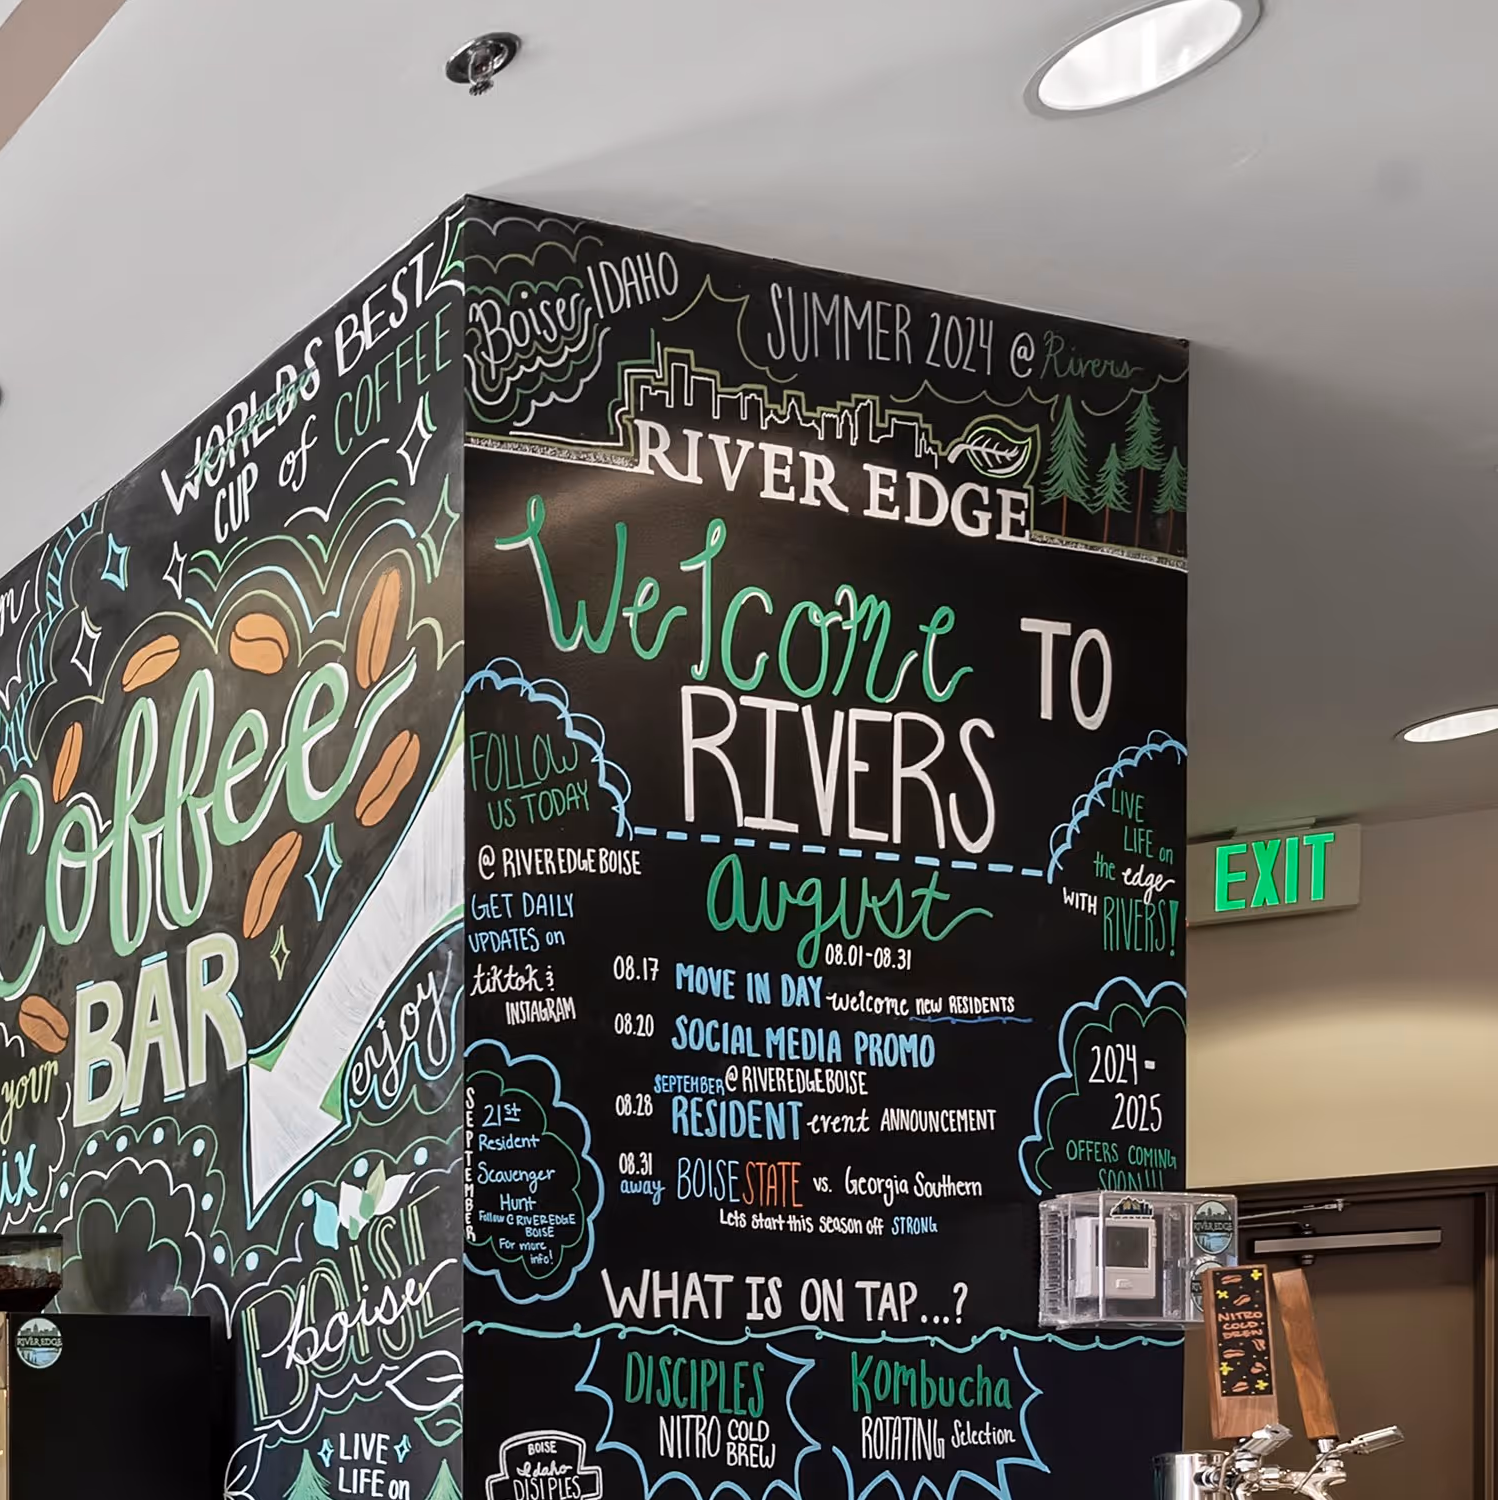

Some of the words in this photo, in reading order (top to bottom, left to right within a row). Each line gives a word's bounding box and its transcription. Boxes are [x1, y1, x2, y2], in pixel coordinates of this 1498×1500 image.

[590, 250, 681, 321] IDAHO
[334, 241, 435, 377] BEST
[767, 281, 913, 363] SUMMER
[924, 313, 995, 376] 2024
[1008, 331, 1036, 379] @
[1041, 330, 1144, 381] Rivers
[214, 461, 260, 543] CUP
[278, 414, 318, 492] of
[334, 302, 452, 456] COFFEE
[631, 420, 849, 513] RIVER
[864, 462, 1033, 542] EDGE
[494, 495, 973, 703] Welcome
[1019, 617, 1112, 731] TO
[469, 731, 578, 791] FOLLOW
[680, 686, 995, 853] RIVERS
[487, 798, 517, 830] US
[521, 779, 591, 824] TODAY
[1111, 787, 1145, 822] LIVE
[477, 844, 496, 880] @
[1124, 825, 1154, 859] LIFE
[1159, 846, 1174, 865] on
[1093, 851, 1117, 881] the
[1122, 864, 1176, 904] edge
[1214, 832, 1336, 913] EXIT
[471, 894, 514, 921] GET
[522, 892, 575, 919] DAILY
[1063, 887, 1098, 916] WITH
[1103, 896, 1180, 957] RIVERS!
[468, 928, 540, 954] UPDATES
[545, 931, 566, 946] on
[612, 956, 660, 982] 08.17
[675, 962, 736, 1000] MOVE
[746, 971, 771, 1005] IN
[781, 973, 823, 1008] DAY
[826, 989, 910, 1017] welcome
[915, 996, 943, 1017] new
[948, 995, 1016, 1015] RESIDENTS
[73, 932, 248, 1128] BAR
[350, 951, 454, 1103] enjoy
[505, 997, 577, 1026] INSTAGRAM
[613, 1013, 655, 1038] 08.20
[671, 1015, 761, 1058] SOCIAL
[766, 1025, 843, 1064] MEDIA
[854, 1030, 936, 1069] PROMO
[0, 1060, 59, 1145] your
[654, 1073, 725, 1096] SEPTEMBER
[481, 1103, 522, 1127] 21st
[615, 1094, 654, 1117] 08.28
[671, 1095, 803, 1141] RESIDENT
[806, 1110, 871, 1134] event
[880, 1108, 997, 1133] ANNOUNCEMENT
[1111, 1093, 1163, 1132] 2025
[478, 1133, 540, 1152] Resident
[1066, 1139, 1119, 1163] OFFERS
[1128, 1144, 1178, 1170] COMING
[464, 1087, 476, 1242] SEPTEMBER
[477, 1161, 556, 1193] Scavenger
[618, 1153, 653, 1176] 08.31
[676, 1156, 741, 1202] BOISE
[743, 1160, 804, 1208] STATE
[813, 1175, 833, 1195] vs.
[845, 1165, 909, 1208] Georgia
[914, 1171, 983, 1198] Southern
[500, 1193, 537, 1212] Hunt
[620, 1178, 666, 1205] away
[479, 1210, 505, 1224] Follow
[516, 1213, 576, 1226] RIVEREDGE
[525, 1226, 555, 1238] BOISE
[720, 1208, 747, 1229] Lets
[750, 1212, 787, 1231] start
[787, 1213, 813, 1233] this
[818, 1213, 863, 1236] season
[865, 1216, 885, 1236] off
[891, 1215, 939, 1236] STRONG
[499, 1238, 516, 1250] For
[519, 1241, 547, 1251] more
[530, 1250, 554, 1265] info!
[601, 1268, 734, 1320] WHAT
[744, 1275, 783, 1319] IS
[800, 1279, 848, 1322] ON
[1218, 1311, 1263, 1322] NITRO
[1223, 1321, 1258, 1330] COLD
[17, 1337, 41, 1346] RIVER
[40, 1338, 63, 1347] EDGE
[625, 1351, 765, 1417] DISCIPLES
[850, 1351, 1012, 1413] Kombucha
[339, 1433, 390, 1464] LIVE
[527, 1441, 558, 1456] BOISE
[658, 1414, 721, 1460] NITRO
[727, 1420, 770, 1444] COLD
[726, 1443, 776, 1469] BREW
[860, 1415, 945, 1461] ROTATING
[950, 1424, 1016, 1450] Selection
[338, 1468, 384, 1498] LIFE
[516, 1460, 573, 1478] Idaho
